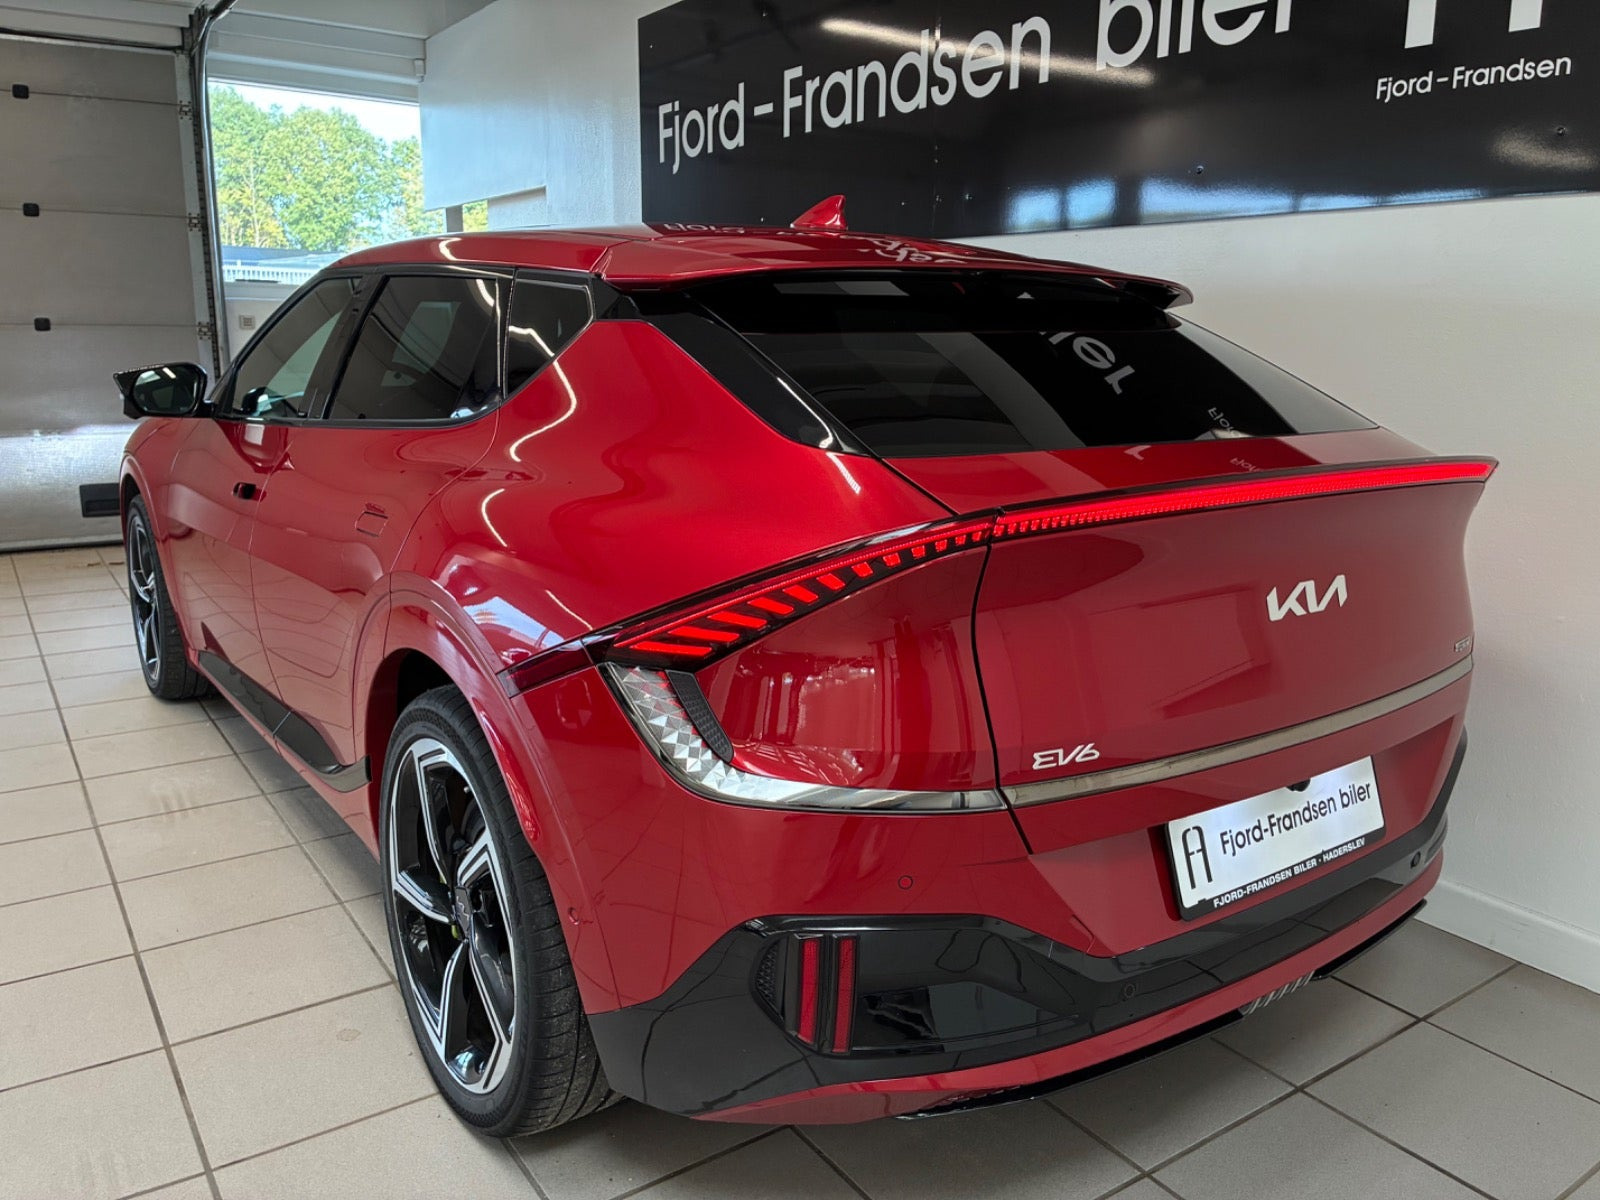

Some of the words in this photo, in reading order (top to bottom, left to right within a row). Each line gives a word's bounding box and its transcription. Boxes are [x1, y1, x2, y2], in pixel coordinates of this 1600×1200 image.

[1033, 743, 1100, 770] EV6
[1220, 795, 1336, 857] Fjord-Frandsen
[1339, 782, 1372, 809] biler
[1213, 868, 1293, 908] FJORD-FRANDSEN
[1294, 857, 1317, 875] BILER
[1322, 838, 1366, 863] HADERSLEV
